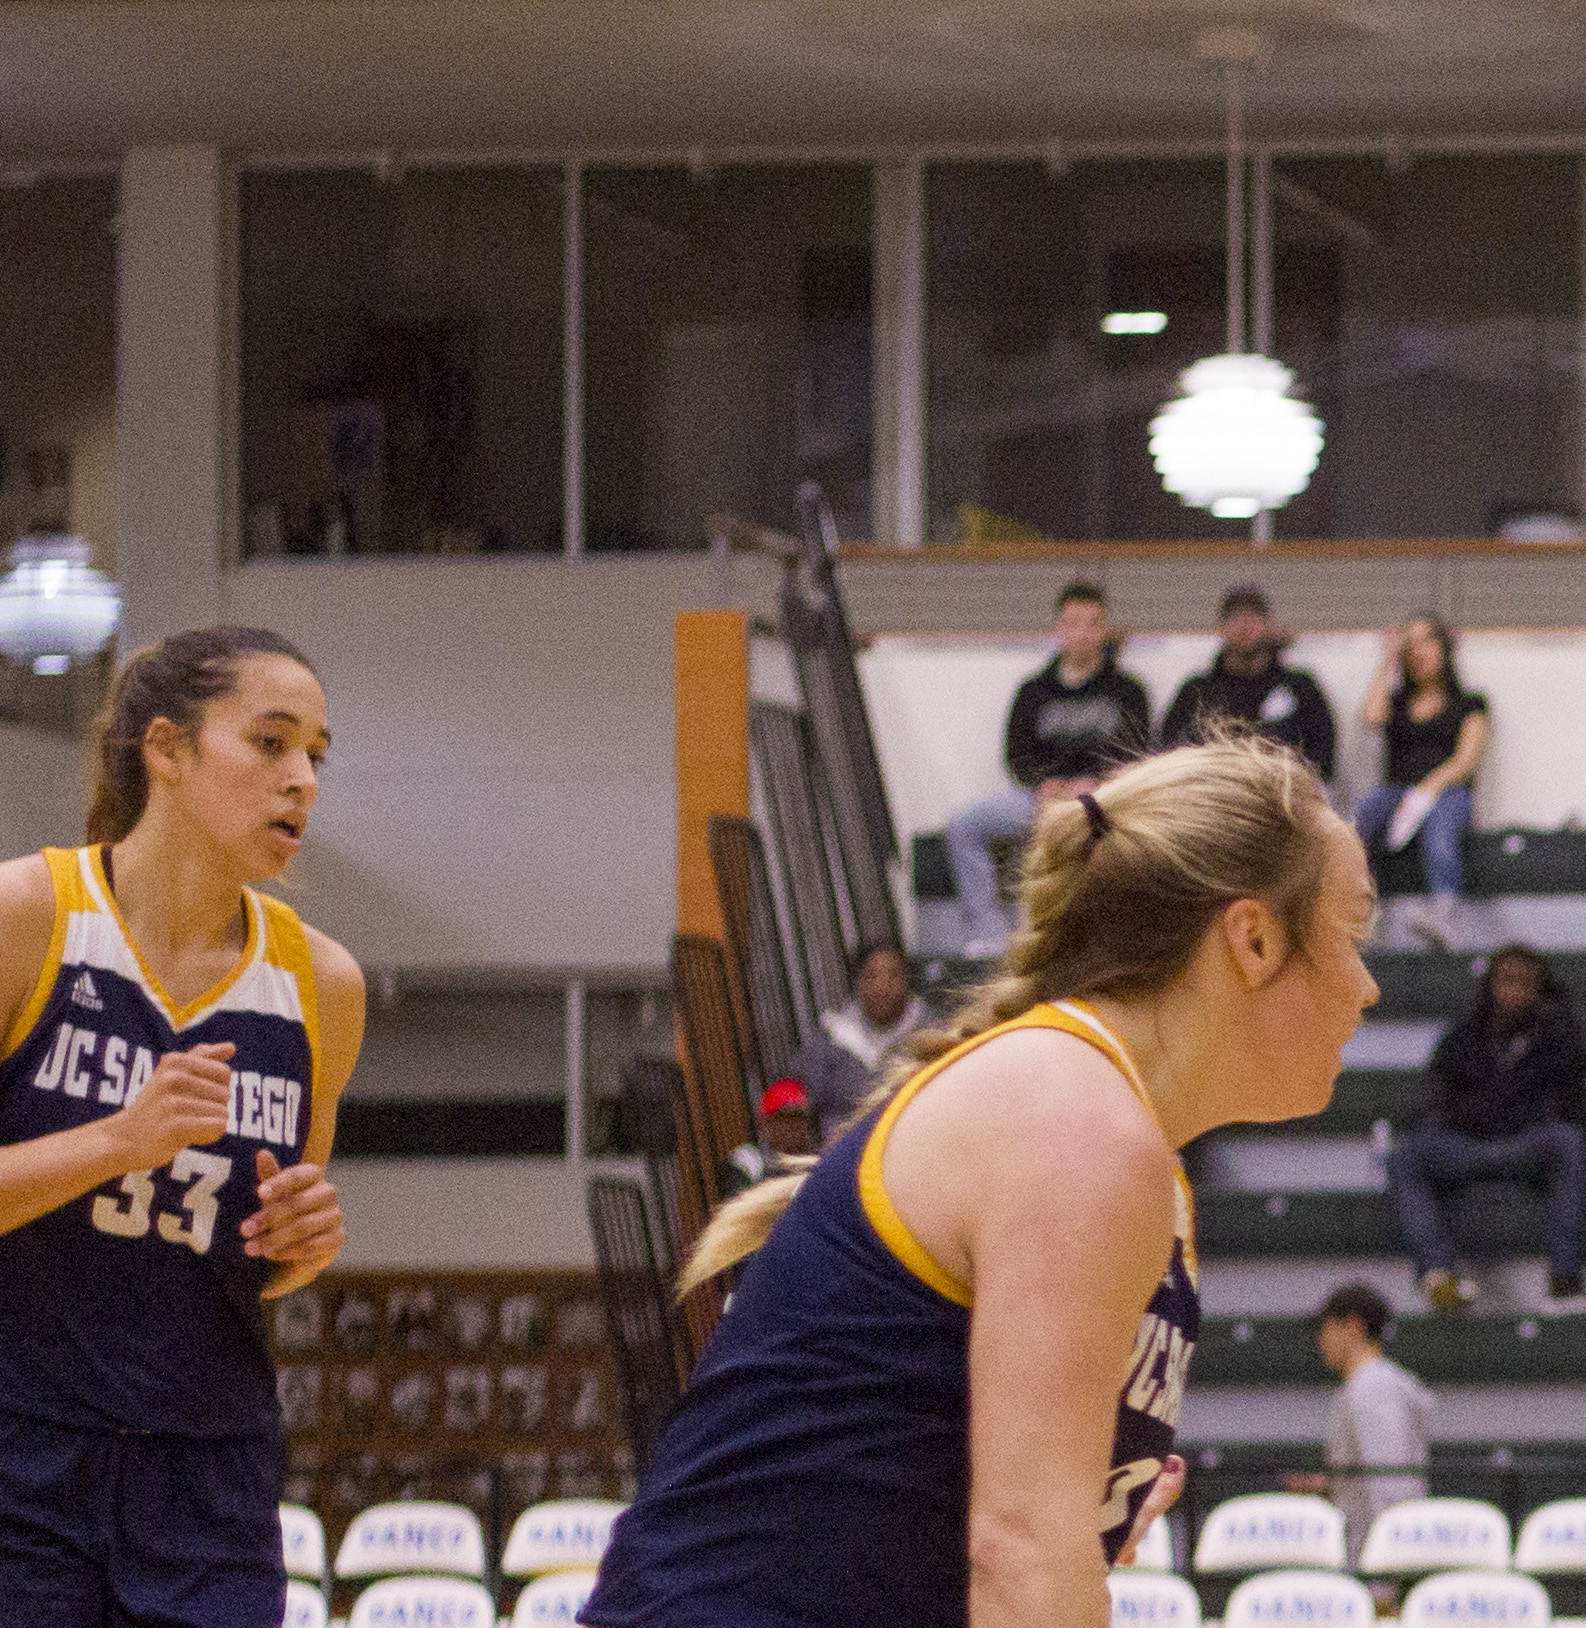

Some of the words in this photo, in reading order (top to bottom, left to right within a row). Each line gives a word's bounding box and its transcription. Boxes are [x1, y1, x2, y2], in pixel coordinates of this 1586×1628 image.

[98, 1035, 155, 1108] SA
[225, 1071, 303, 1149] IEGO
[91, 1150, 233, 1256] 33
